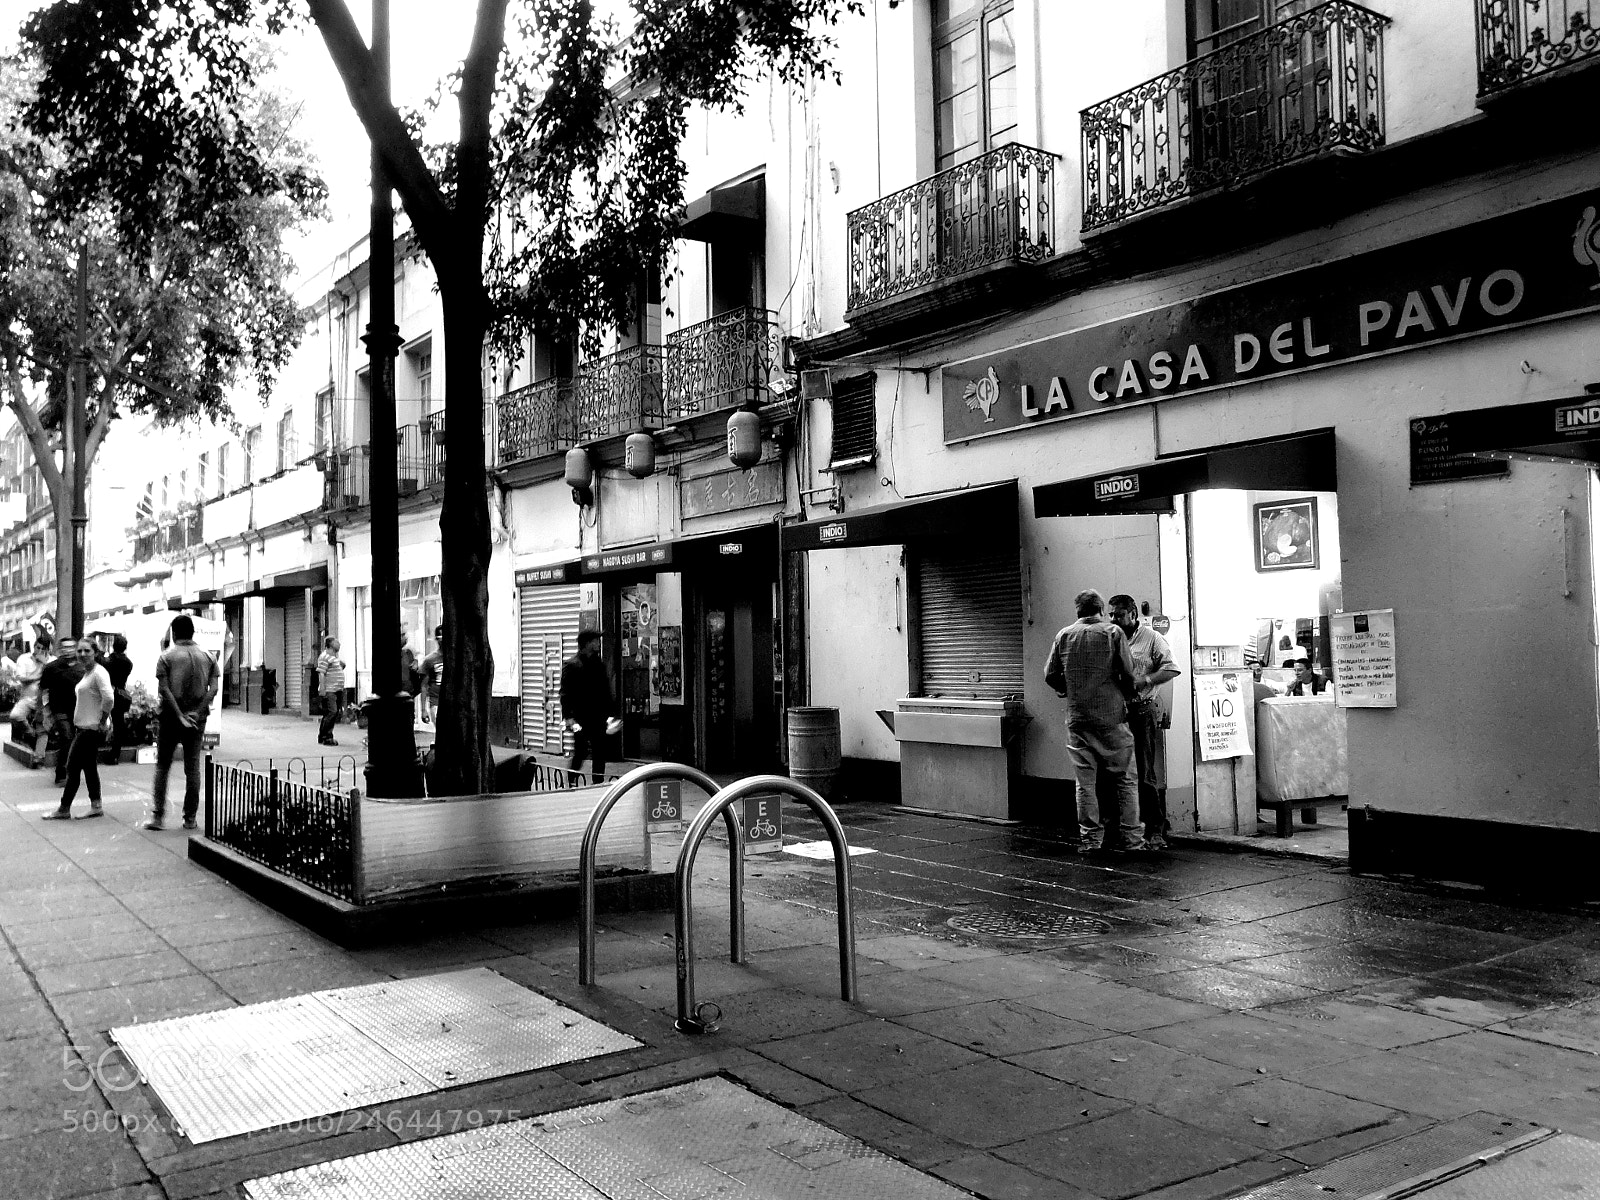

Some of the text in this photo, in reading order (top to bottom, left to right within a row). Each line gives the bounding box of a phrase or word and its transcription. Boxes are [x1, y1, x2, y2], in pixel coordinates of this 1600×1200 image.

[1021, 269, 1525, 417] LA CASA DEL PAVO
[1100, 478, 1133, 495] INDIO
[822, 526, 843, 538] INDIO
[621, 553, 636, 566] SUSHI
[636, 551, 647, 563] BAR
[1211, 698, 1234, 718] NO
[660, 785, 668, 799] E
[758, 801, 767, 817] E
